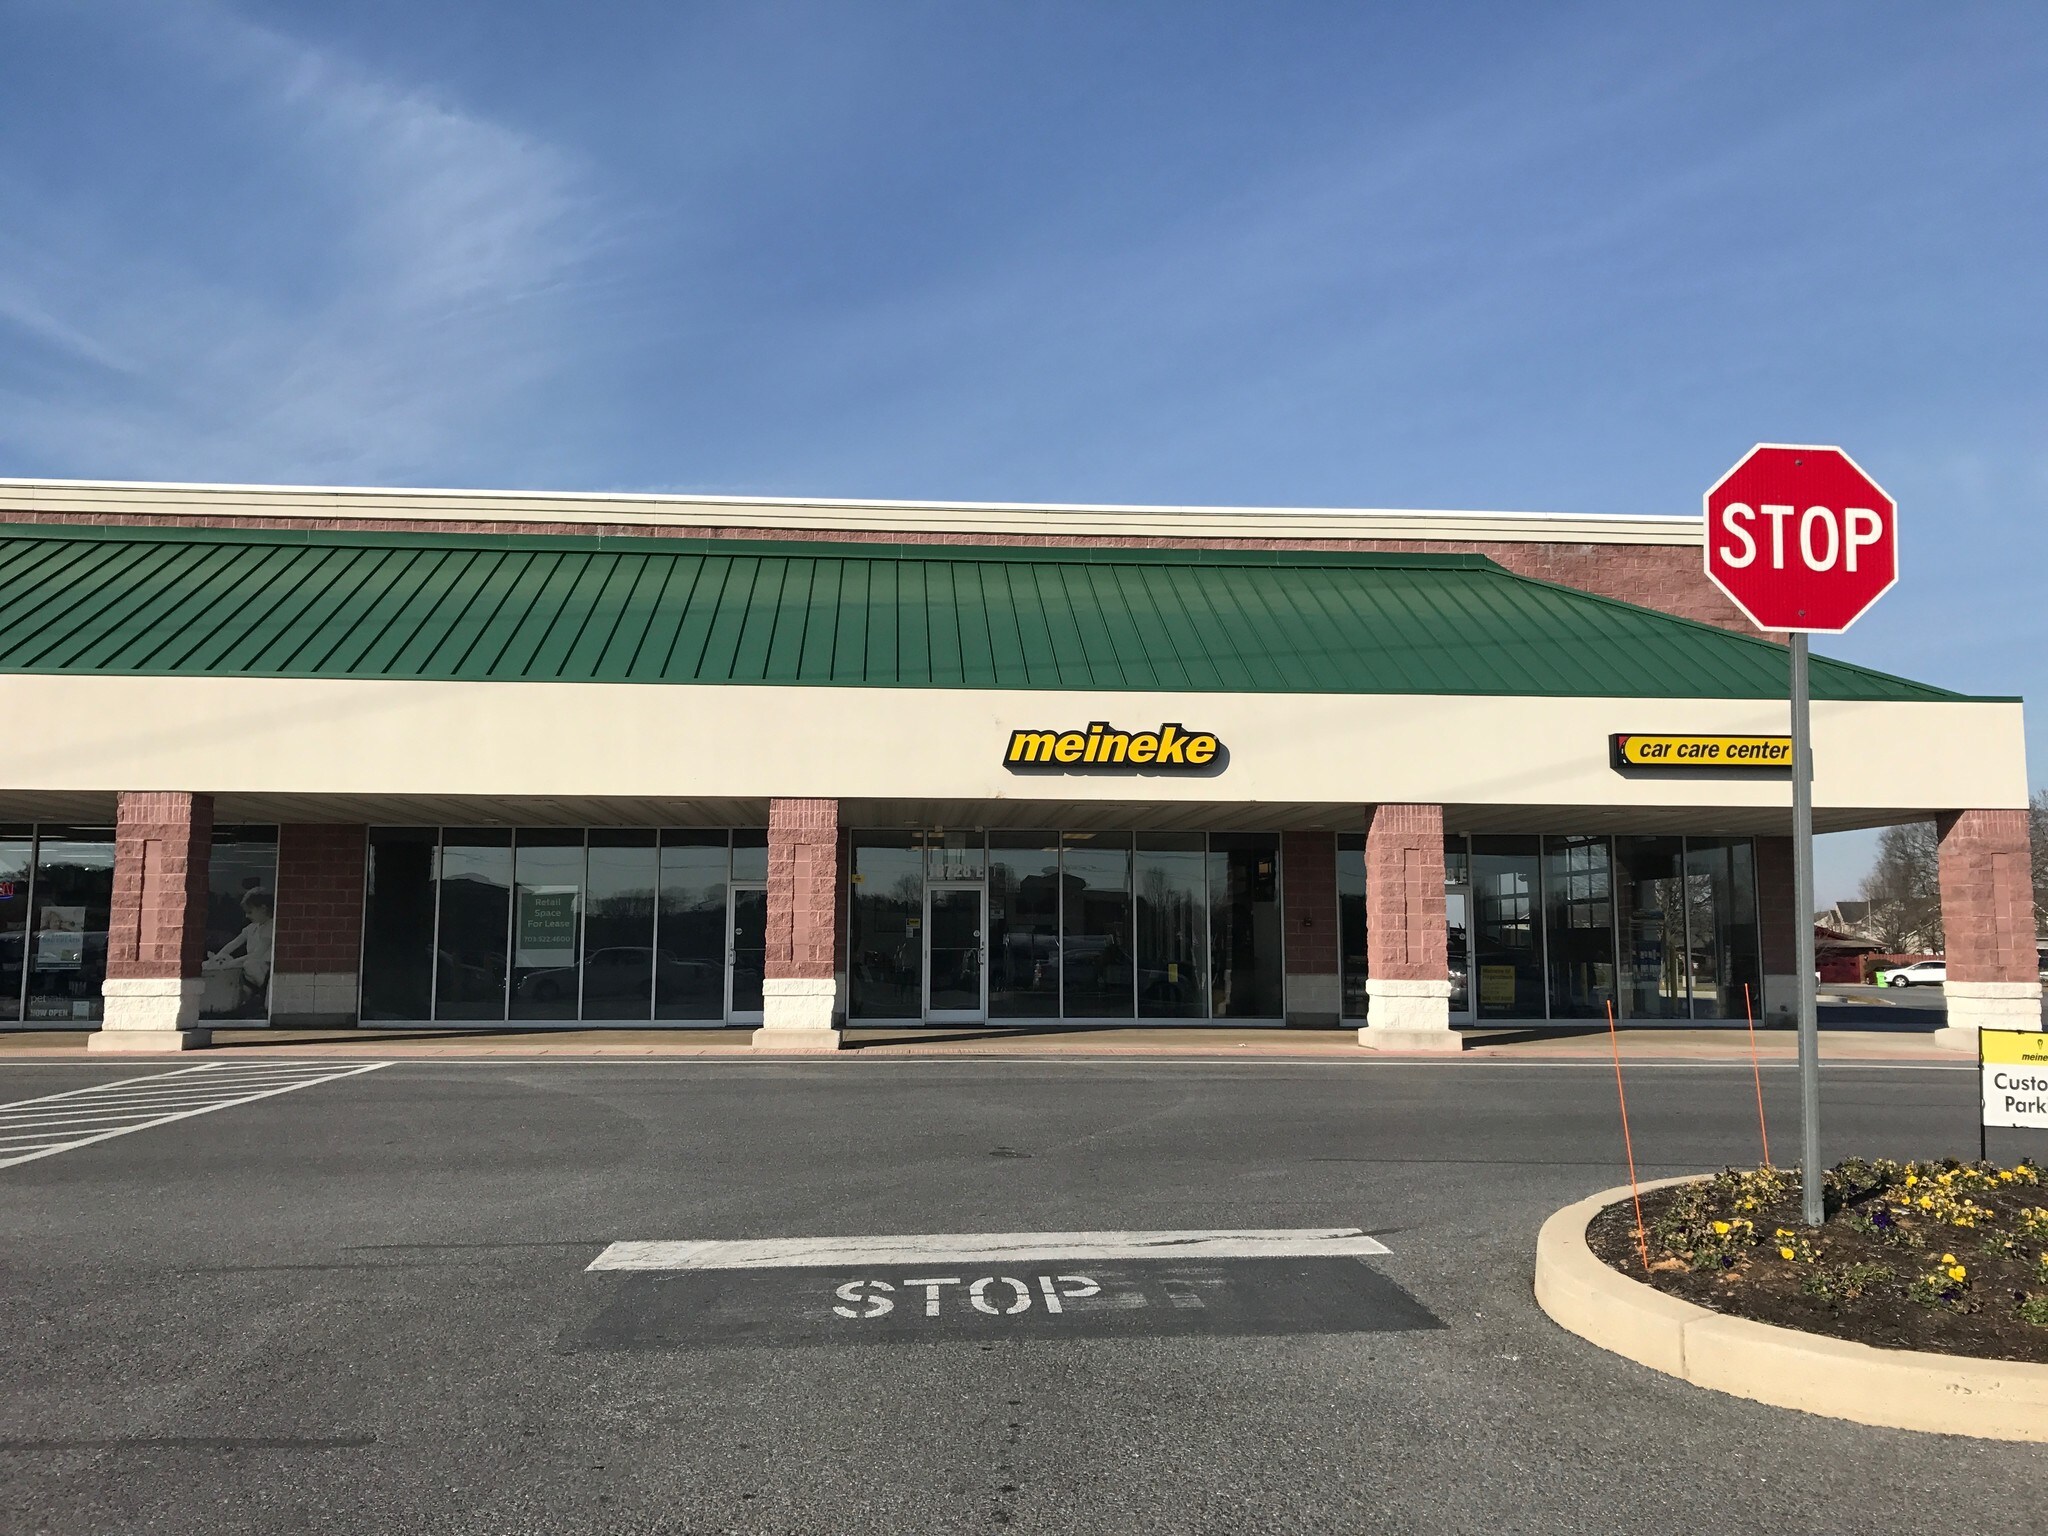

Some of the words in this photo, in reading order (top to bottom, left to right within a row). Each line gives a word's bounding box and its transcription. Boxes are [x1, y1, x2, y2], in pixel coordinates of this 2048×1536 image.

[1719, 502, 1883, 573] STOP
[1008, 725, 1218, 764] meineke
[1640, 743, 1672, 758] car
[1676, 743, 1720, 758] care
[1726, 741, 1790, 759] center
[535, 898, 561, 906] Retail
[534, 909, 562, 918] Space
[527, 920, 543, 928] For
[544, 920, 570, 928] Lease
[30, 1008, 48, 1017] NOW
[48, 1008, 69, 1017] OPEN
[1994, 1072, 2048, 1091] Custo
[2005, 1096, 2047, 1114] Park
[832, 1275, 1101, 1318] STOP
